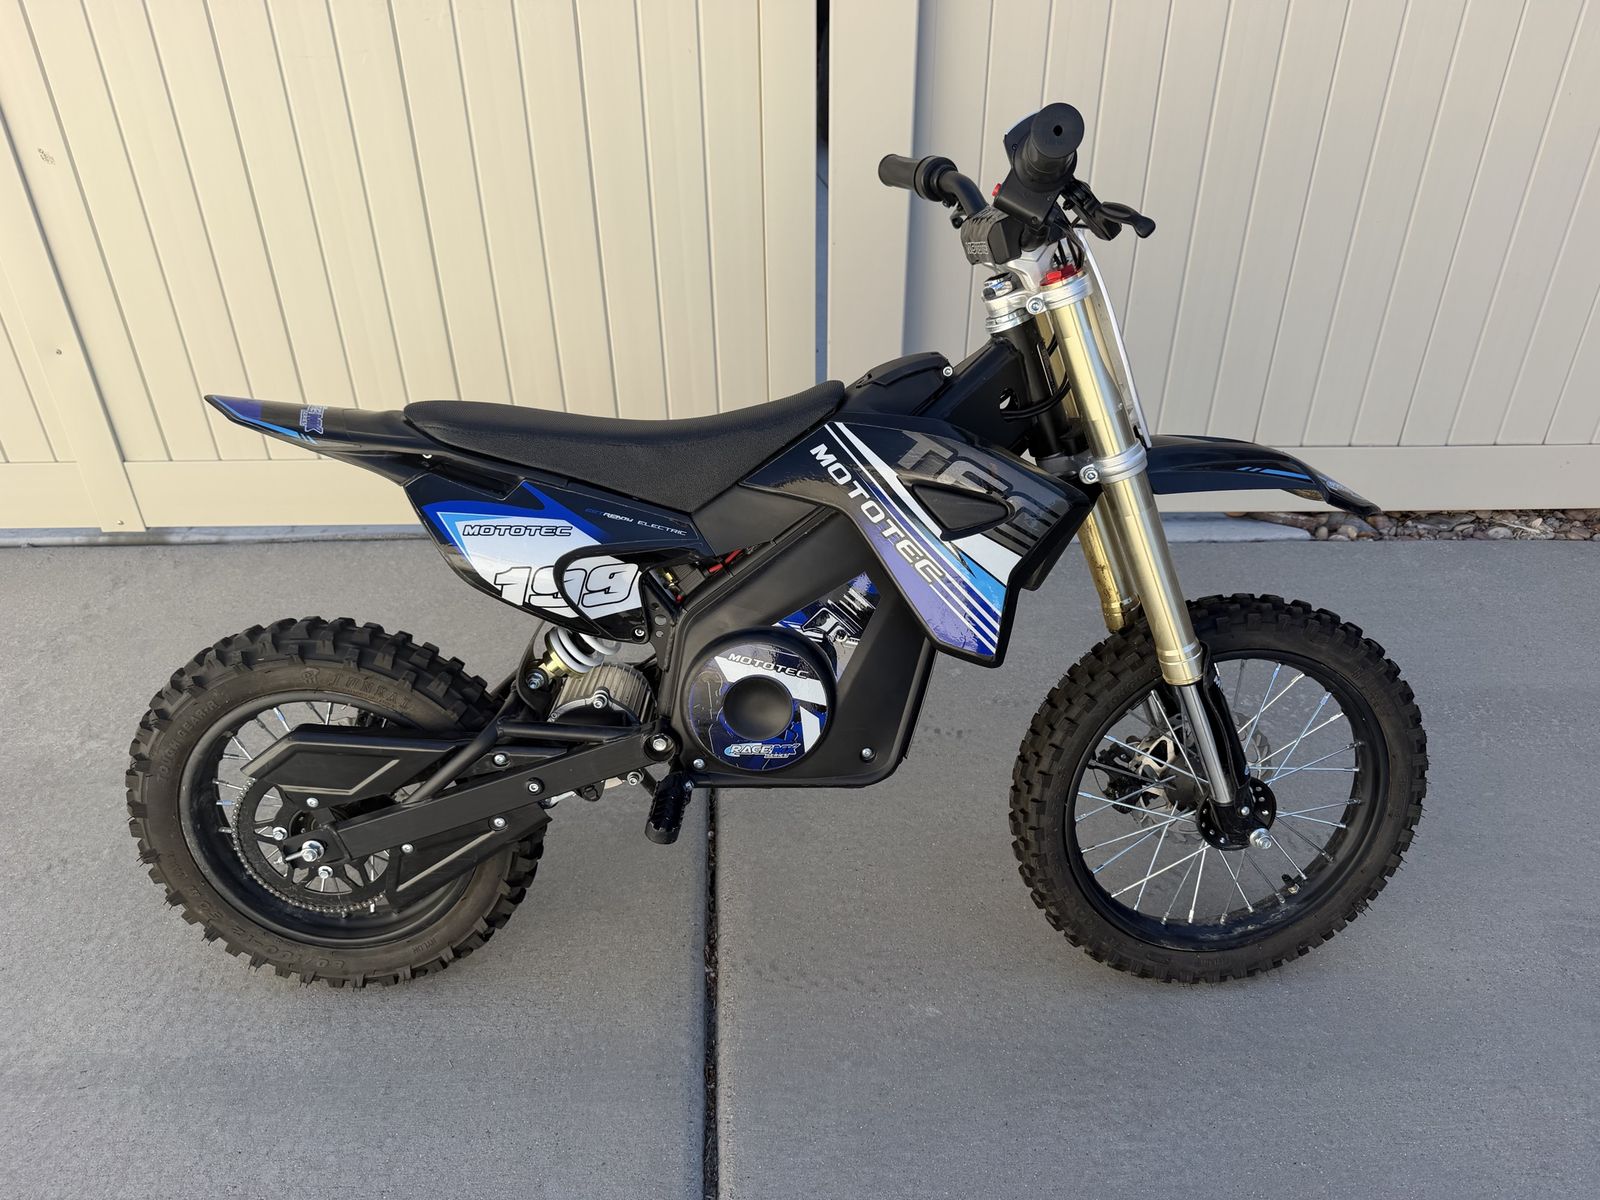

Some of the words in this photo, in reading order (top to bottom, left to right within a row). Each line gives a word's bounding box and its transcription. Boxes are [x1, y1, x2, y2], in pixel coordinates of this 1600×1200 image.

[809, 442, 947, 586] MOTOTEC
[462, 524, 574, 538] MOTOTEC
[637, 520, 688, 536] ELECTRIC
[494, 562, 640, 609] 199
[728, 652, 811, 680] MOTOTEC
[730, 743, 771, 756] RACE
